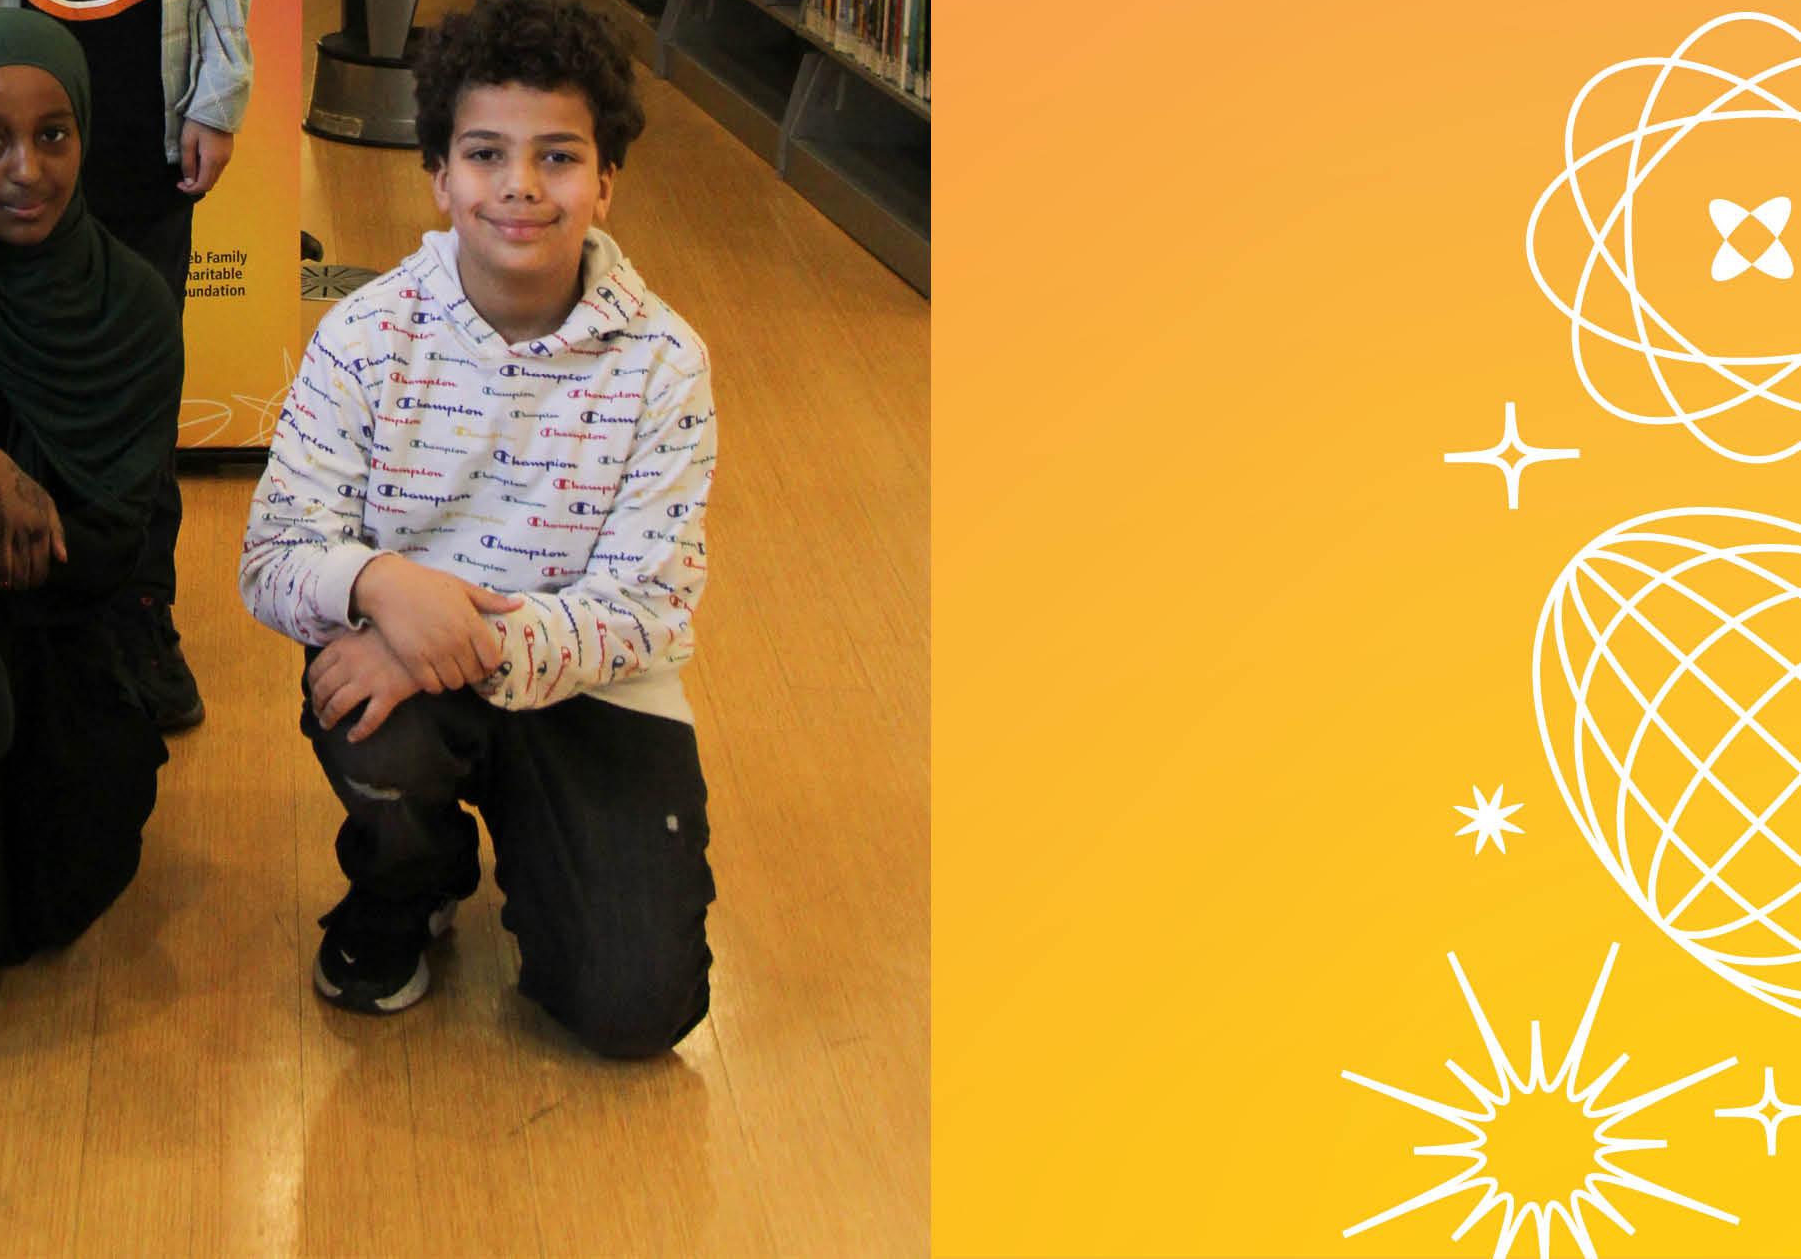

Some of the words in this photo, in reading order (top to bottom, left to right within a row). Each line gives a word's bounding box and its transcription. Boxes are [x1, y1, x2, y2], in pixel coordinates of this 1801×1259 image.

[206, 250, 248, 267] Family
[185, 267, 243, 281] haritable
[183, 285, 246, 298] oundation
[389, 372, 457, 389] Champion
[396, 397, 484, 418] Champion
[539, 427, 608, 444] Champion
[492, 450, 579, 471] Champion
[377, 484, 473, 508] Champion
[480, 534, 569, 560] Champion
